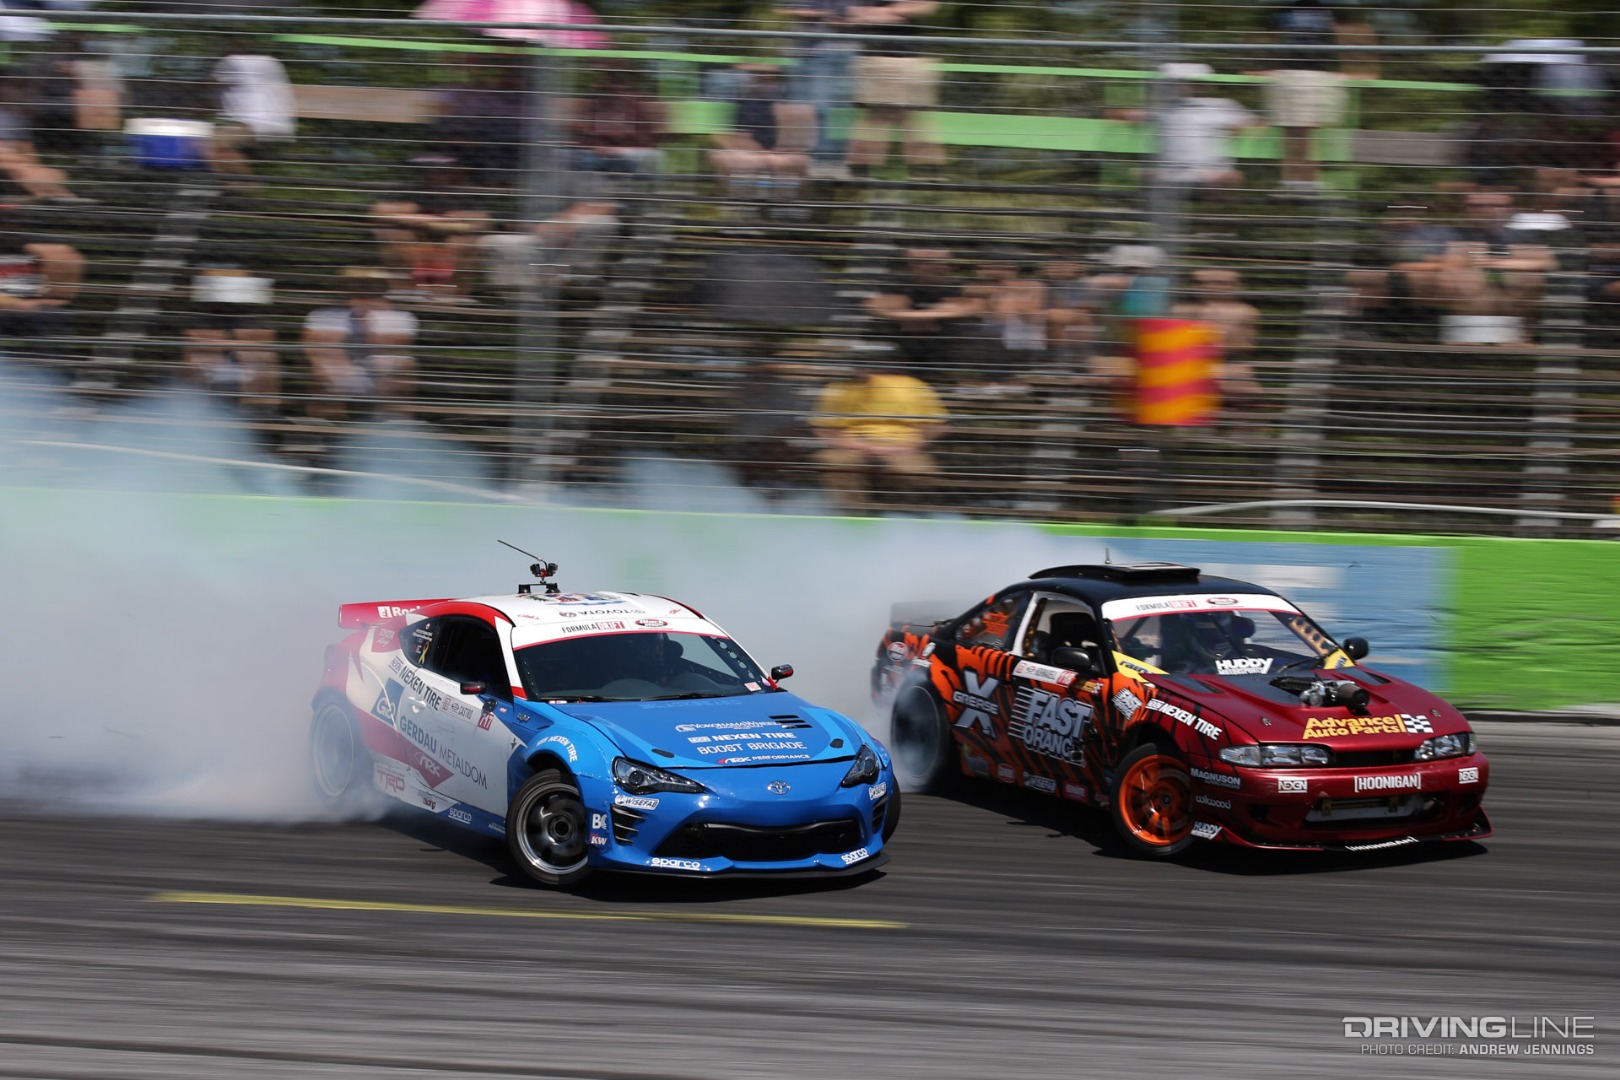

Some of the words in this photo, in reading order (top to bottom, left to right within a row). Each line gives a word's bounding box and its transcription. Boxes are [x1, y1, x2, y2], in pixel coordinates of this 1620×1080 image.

[562, 623, 596, 634] FORMULA
[1215, 658, 1273, 672] HUDDY
[399, 665, 424, 694] NEXEN
[423, 685, 442, 710] TIRE
[953, 691, 998, 715] GREASE
[1026, 688, 1093, 738] FAST
[1158, 702, 1196, 726] NEXEN
[1195, 718, 1222, 740] TIRE
[1305, 716, 1396, 728] Advance
[713, 732, 761, 742] NEXEN
[762, 731, 797, 740] TIRE
[1303, 725, 1350, 739] Auto
[1350, 723, 1401, 735] Parts
[697, 743, 743, 755] BOOST
[747, 741, 808, 751] BRIGADE
[1023, 724, 1083, 763] ORANG
[400, 715, 437, 754] GERDAU
[439, 745, 488, 790] METALDOM
[1190, 768, 1241, 786] MAGNUSON
[625, 798, 657, 808] WISEFAB
[449, 808, 472, 823] sparco
[590, 836, 607, 846] KW
[651, 858, 701, 869] sparco
